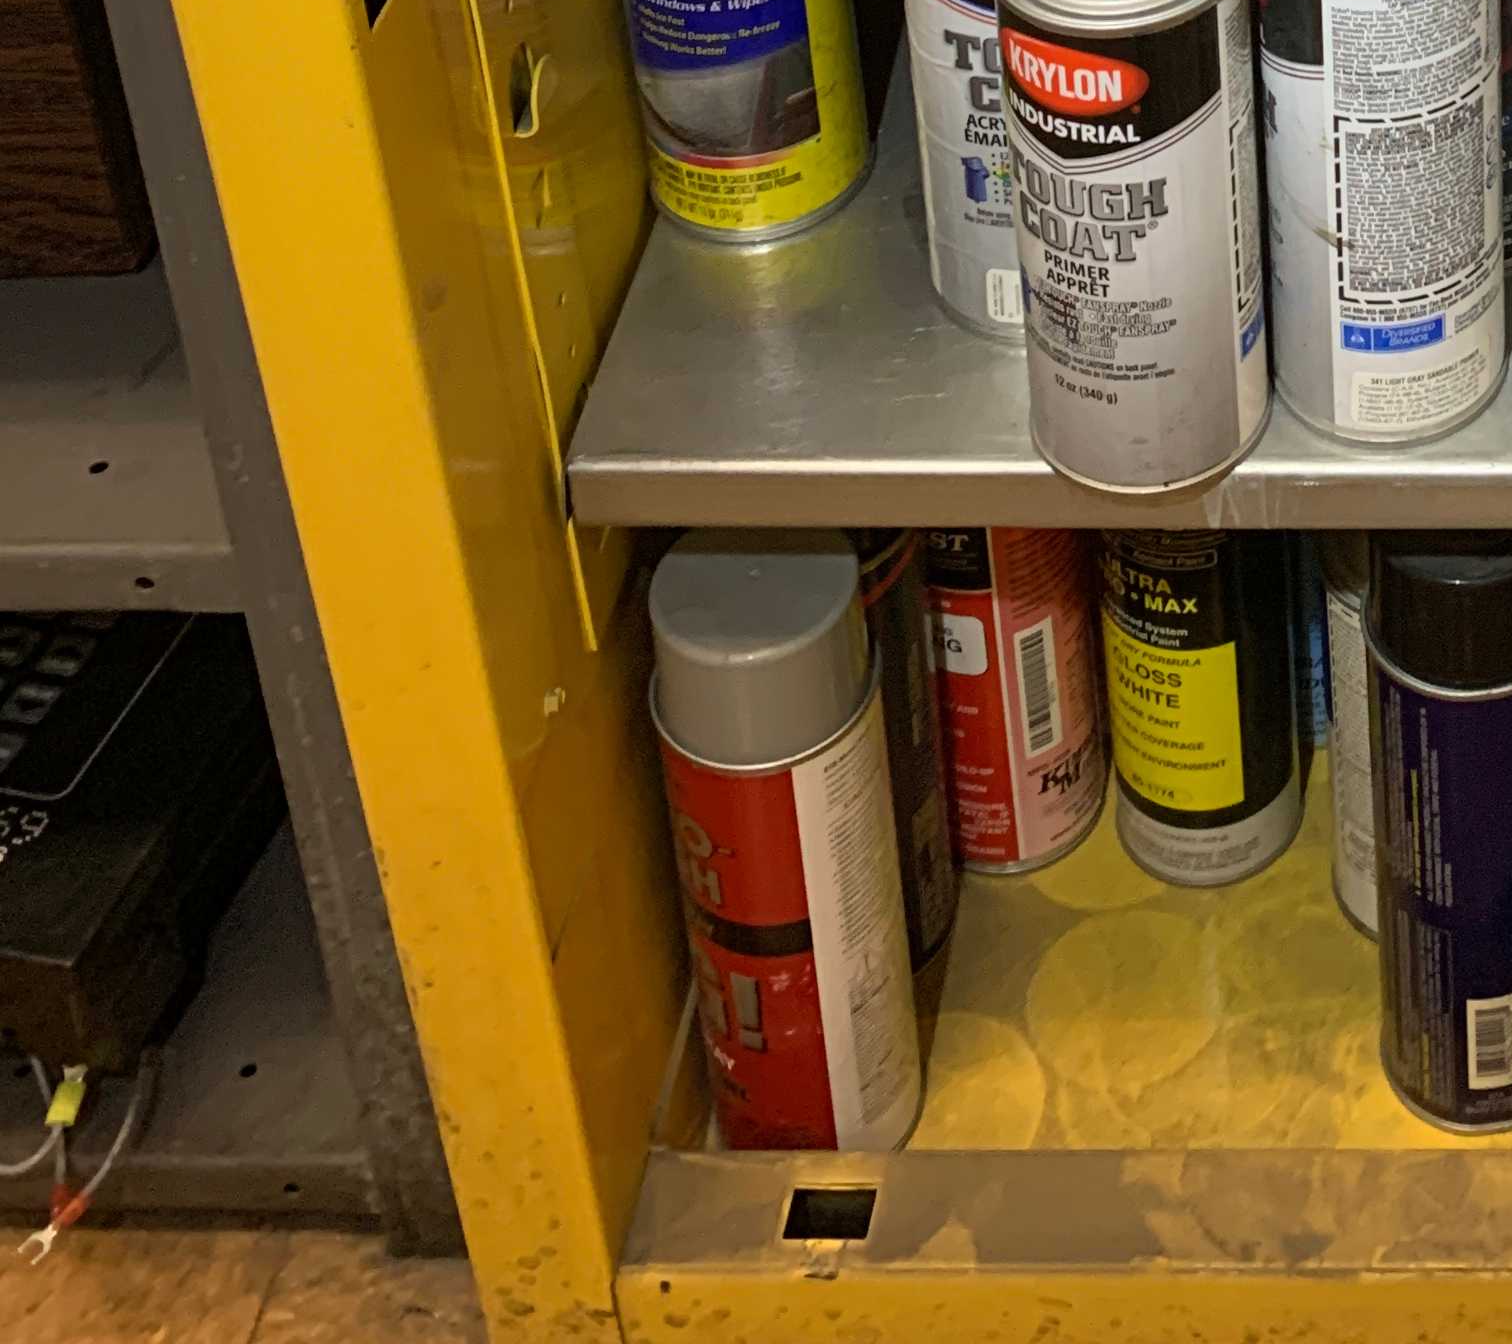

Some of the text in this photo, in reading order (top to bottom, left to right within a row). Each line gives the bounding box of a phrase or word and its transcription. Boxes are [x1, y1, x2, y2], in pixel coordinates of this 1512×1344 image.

[1009, 38, 1123, 102] KRYLON
[1009, 87, 1141, 144] INDUSTRIAL
[1010, 144, 1168, 221] TOUGH
[1019, 190, 1146, 262] COAT
[1044, 249, 1110, 282] PRIMER
[1046, 268, 1110, 298] APPRÊT
[1144, 593, 1198, 614] MAX
[1145, 621, 1188, 637] System
[1142, 651, 1201, 667] FORMULA
[1141, 729, 1205, 751] COVERAGE
